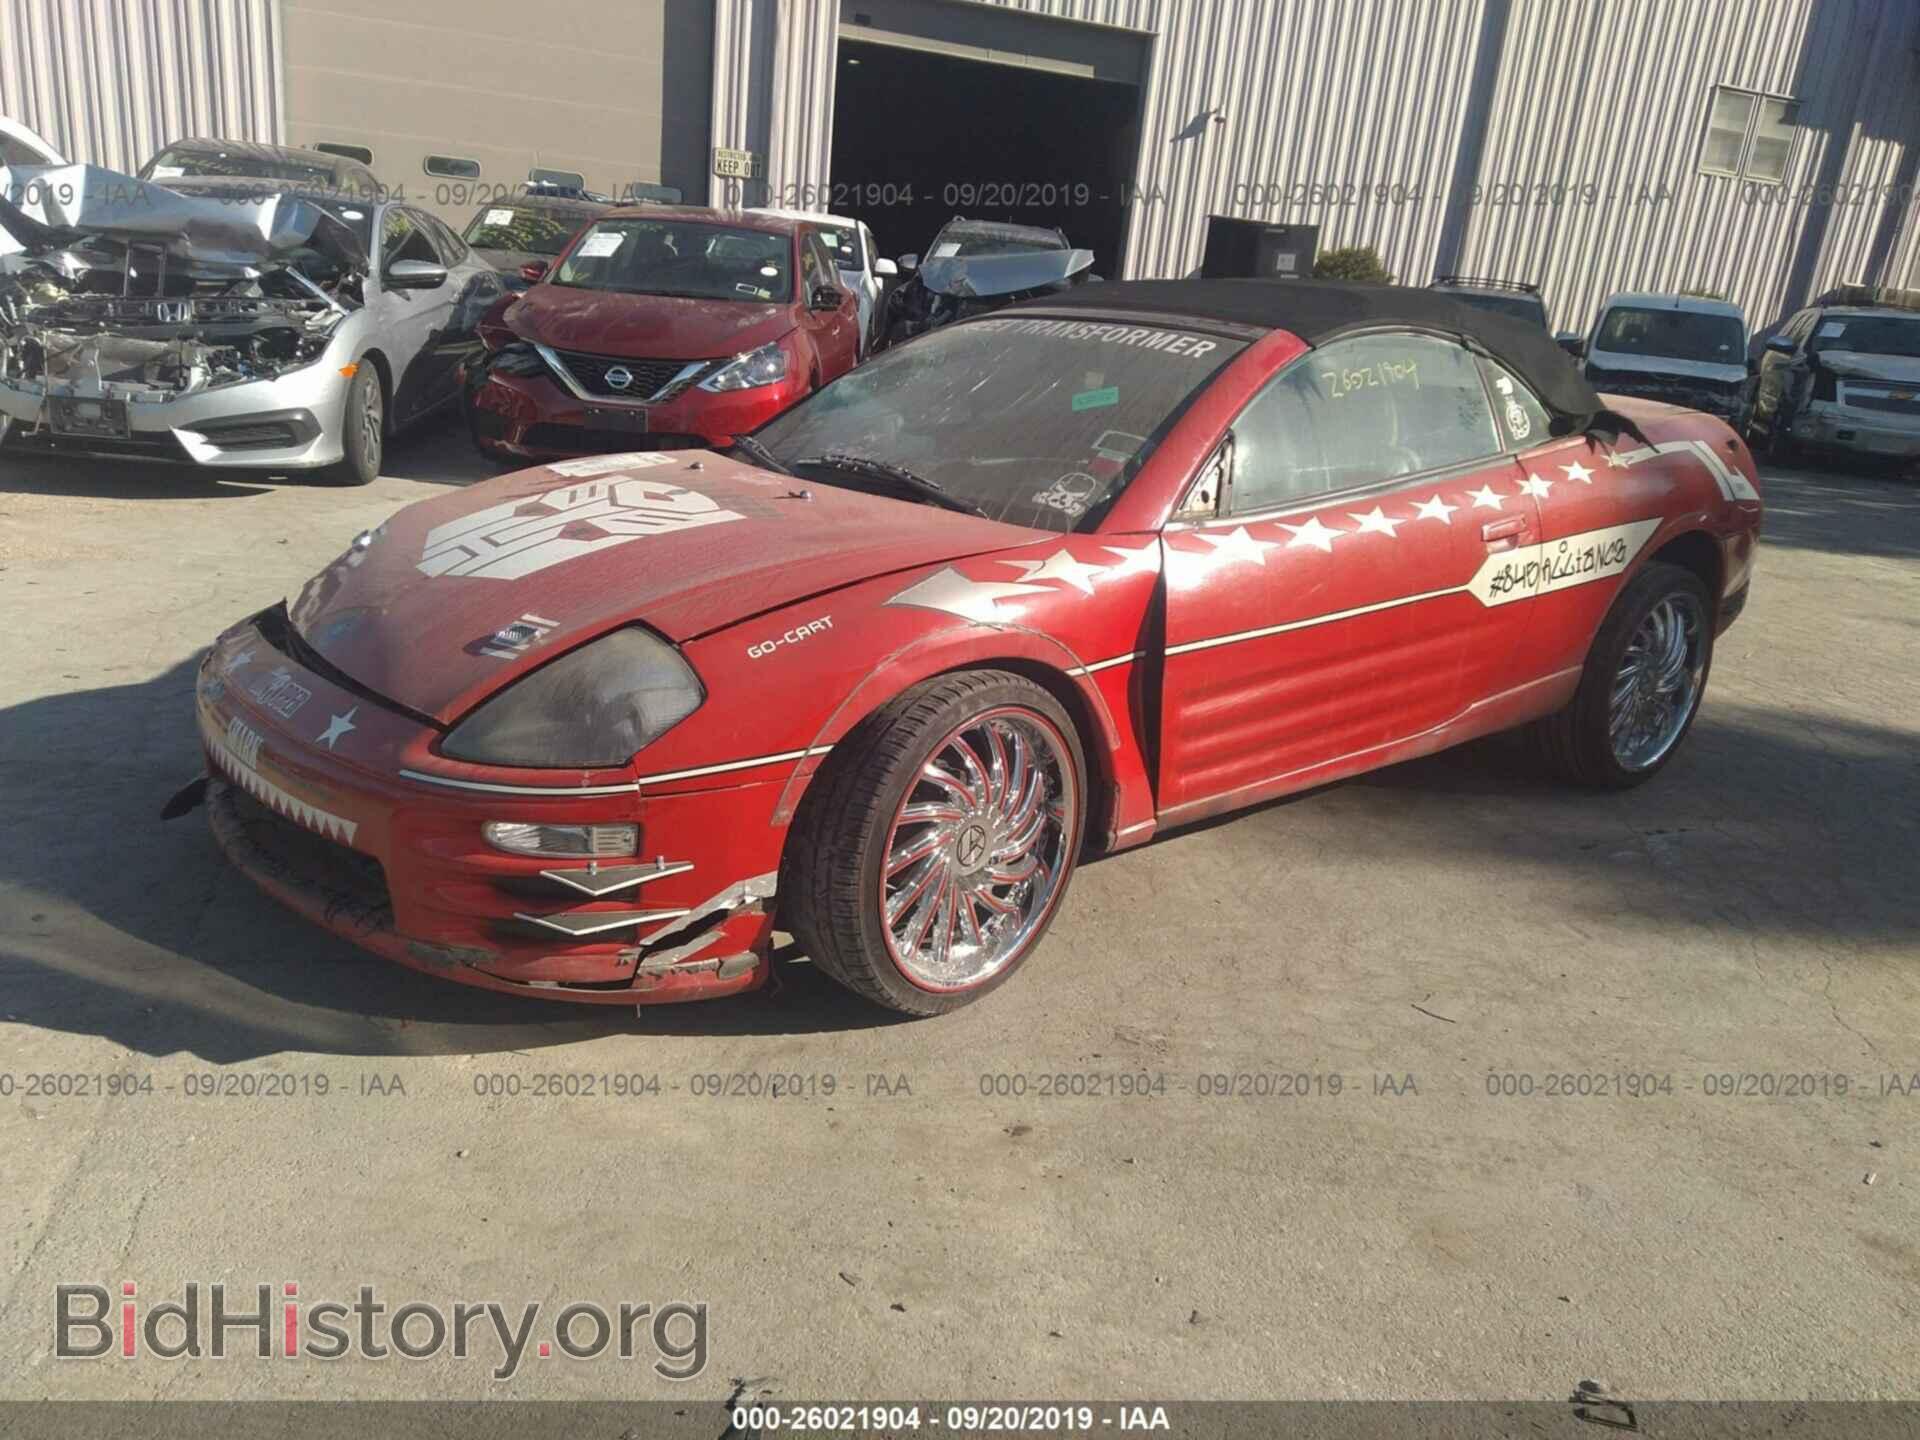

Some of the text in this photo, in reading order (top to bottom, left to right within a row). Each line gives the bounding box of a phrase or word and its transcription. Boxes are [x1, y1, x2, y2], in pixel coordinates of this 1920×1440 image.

[716, 159, 761, 177] KEEP OUT
[1014, 319, 1217, 358] TRANSFORMER
[1321, 356, 1420, 398] 26021904
[747, 615, 833, 659] GO-CART
